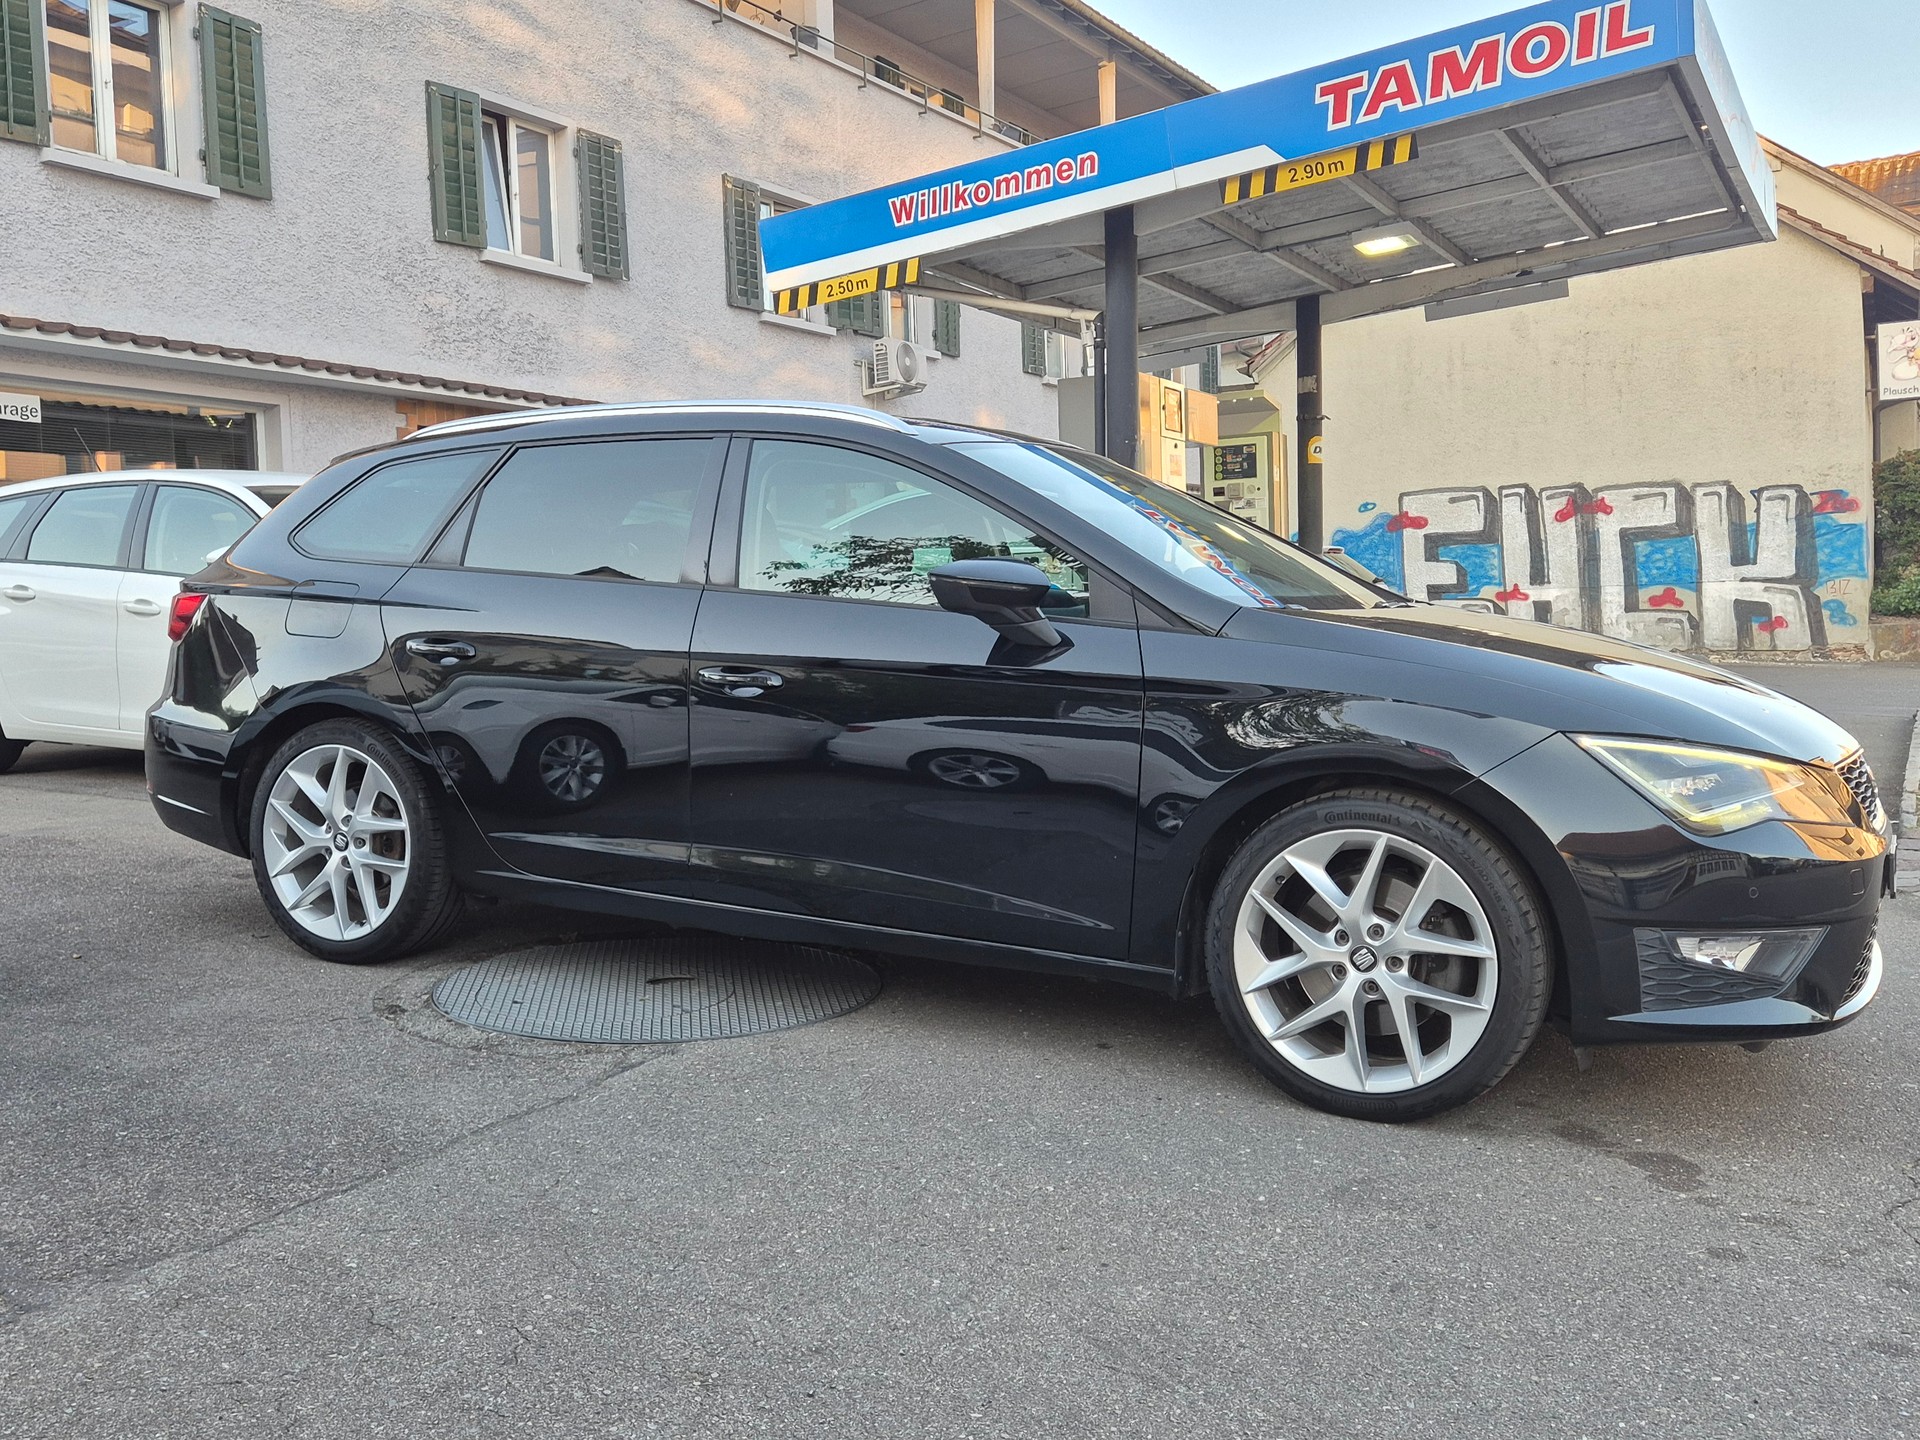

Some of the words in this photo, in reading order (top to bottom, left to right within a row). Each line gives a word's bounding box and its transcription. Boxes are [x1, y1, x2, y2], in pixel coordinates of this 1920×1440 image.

[1315, 0, 1655, 131] TAMOIL
[889, 152, 1098, 226] Willkommen
[1884, 385, 1919, 395] Plausch
[0, 404, 38, 420] rage
[1324, 810, 1392, 825] Continental
